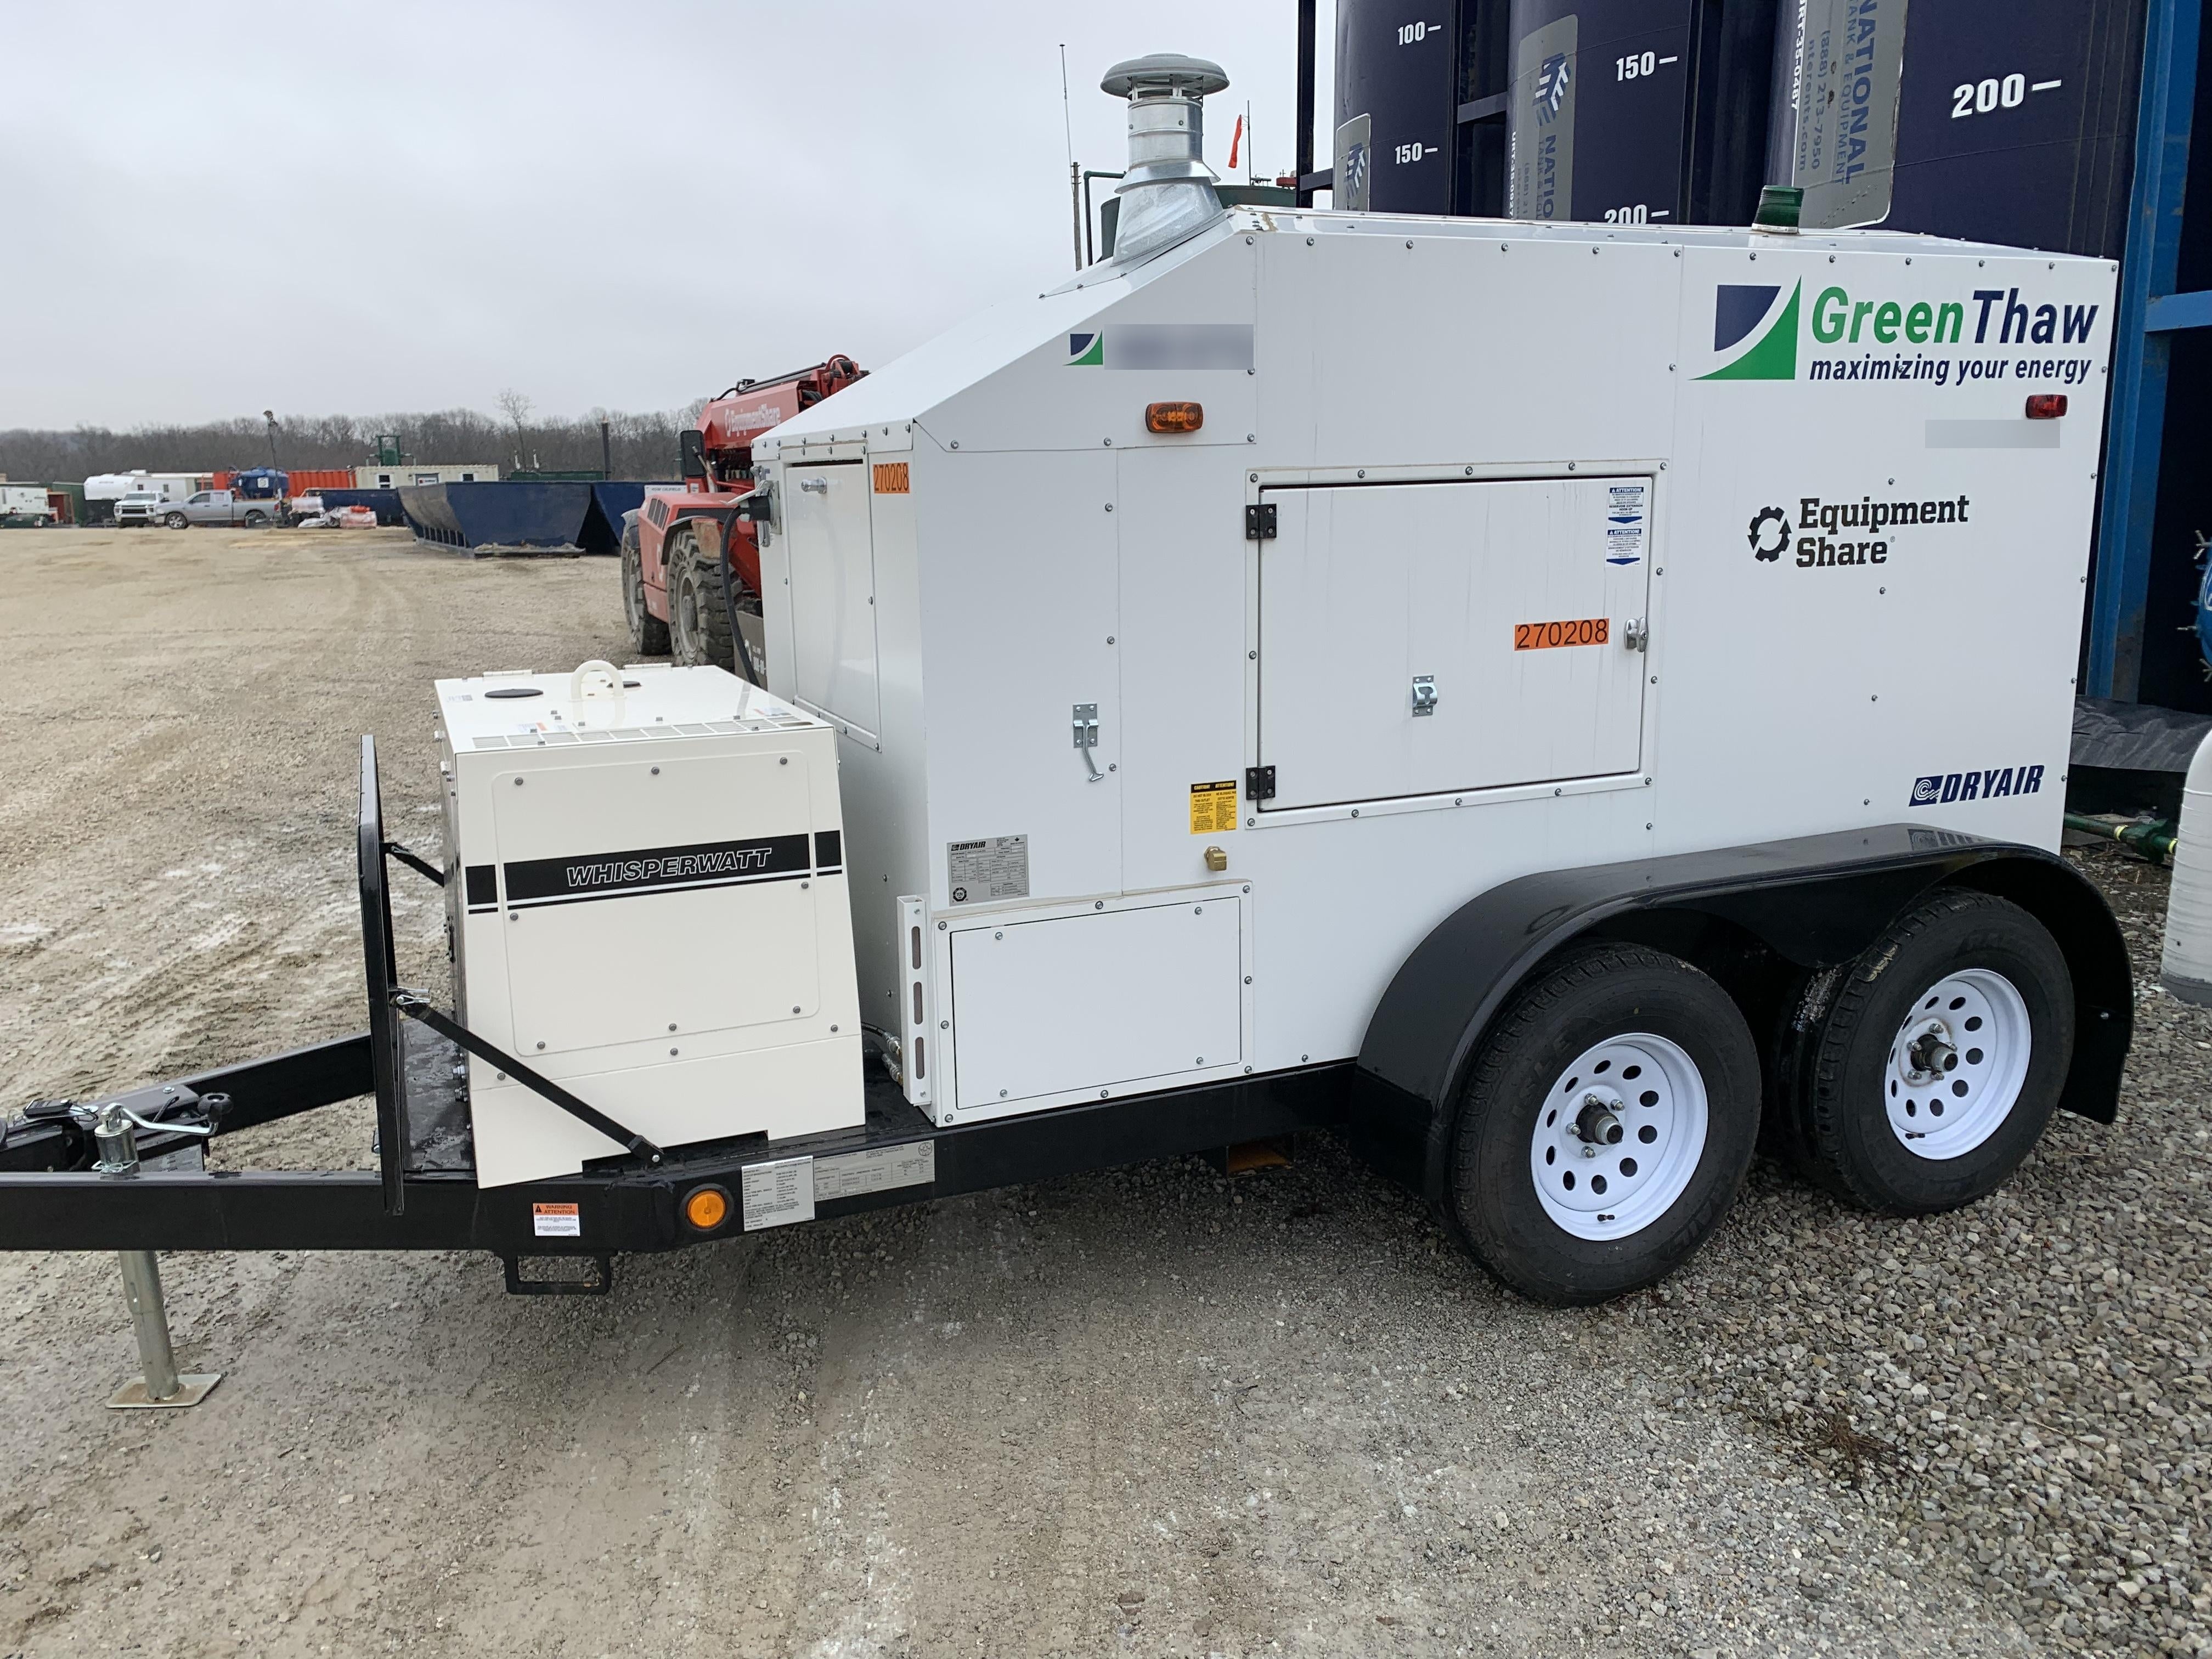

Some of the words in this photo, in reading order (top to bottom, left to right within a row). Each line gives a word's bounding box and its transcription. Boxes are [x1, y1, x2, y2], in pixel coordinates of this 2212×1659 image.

[1398, 21, 1425, 46] 100
[1616, 51, 1655, 81] 150
[1817, 30, 1831, 78] (888)
[1951, 72, 2025, 120] 200
[1811, 83, 1826, 170] 213-7950
[1835, 72, 1853, 185] EQUIPMENT
[1395, 142, 1422, 165] 150
[1543, 134, 1556, 218] NATIO
[1809, 353, 1950, 386] maximizing
[1956, 359, 2010, 386] your
[2015, 359, 2093, 385] energy
[873, 462, 909, 492] 270208
[1798, 495, 1970, 535] Equipment
[1796, 536, 1888, 568] Share
[1516, 618, 1608, 649] 270208
[1939, 765, 2045, 803] DRYAIR
[960, 841, 986, 850] DRYAIR
[567, 848, 772, 887] WHISPERWATT
